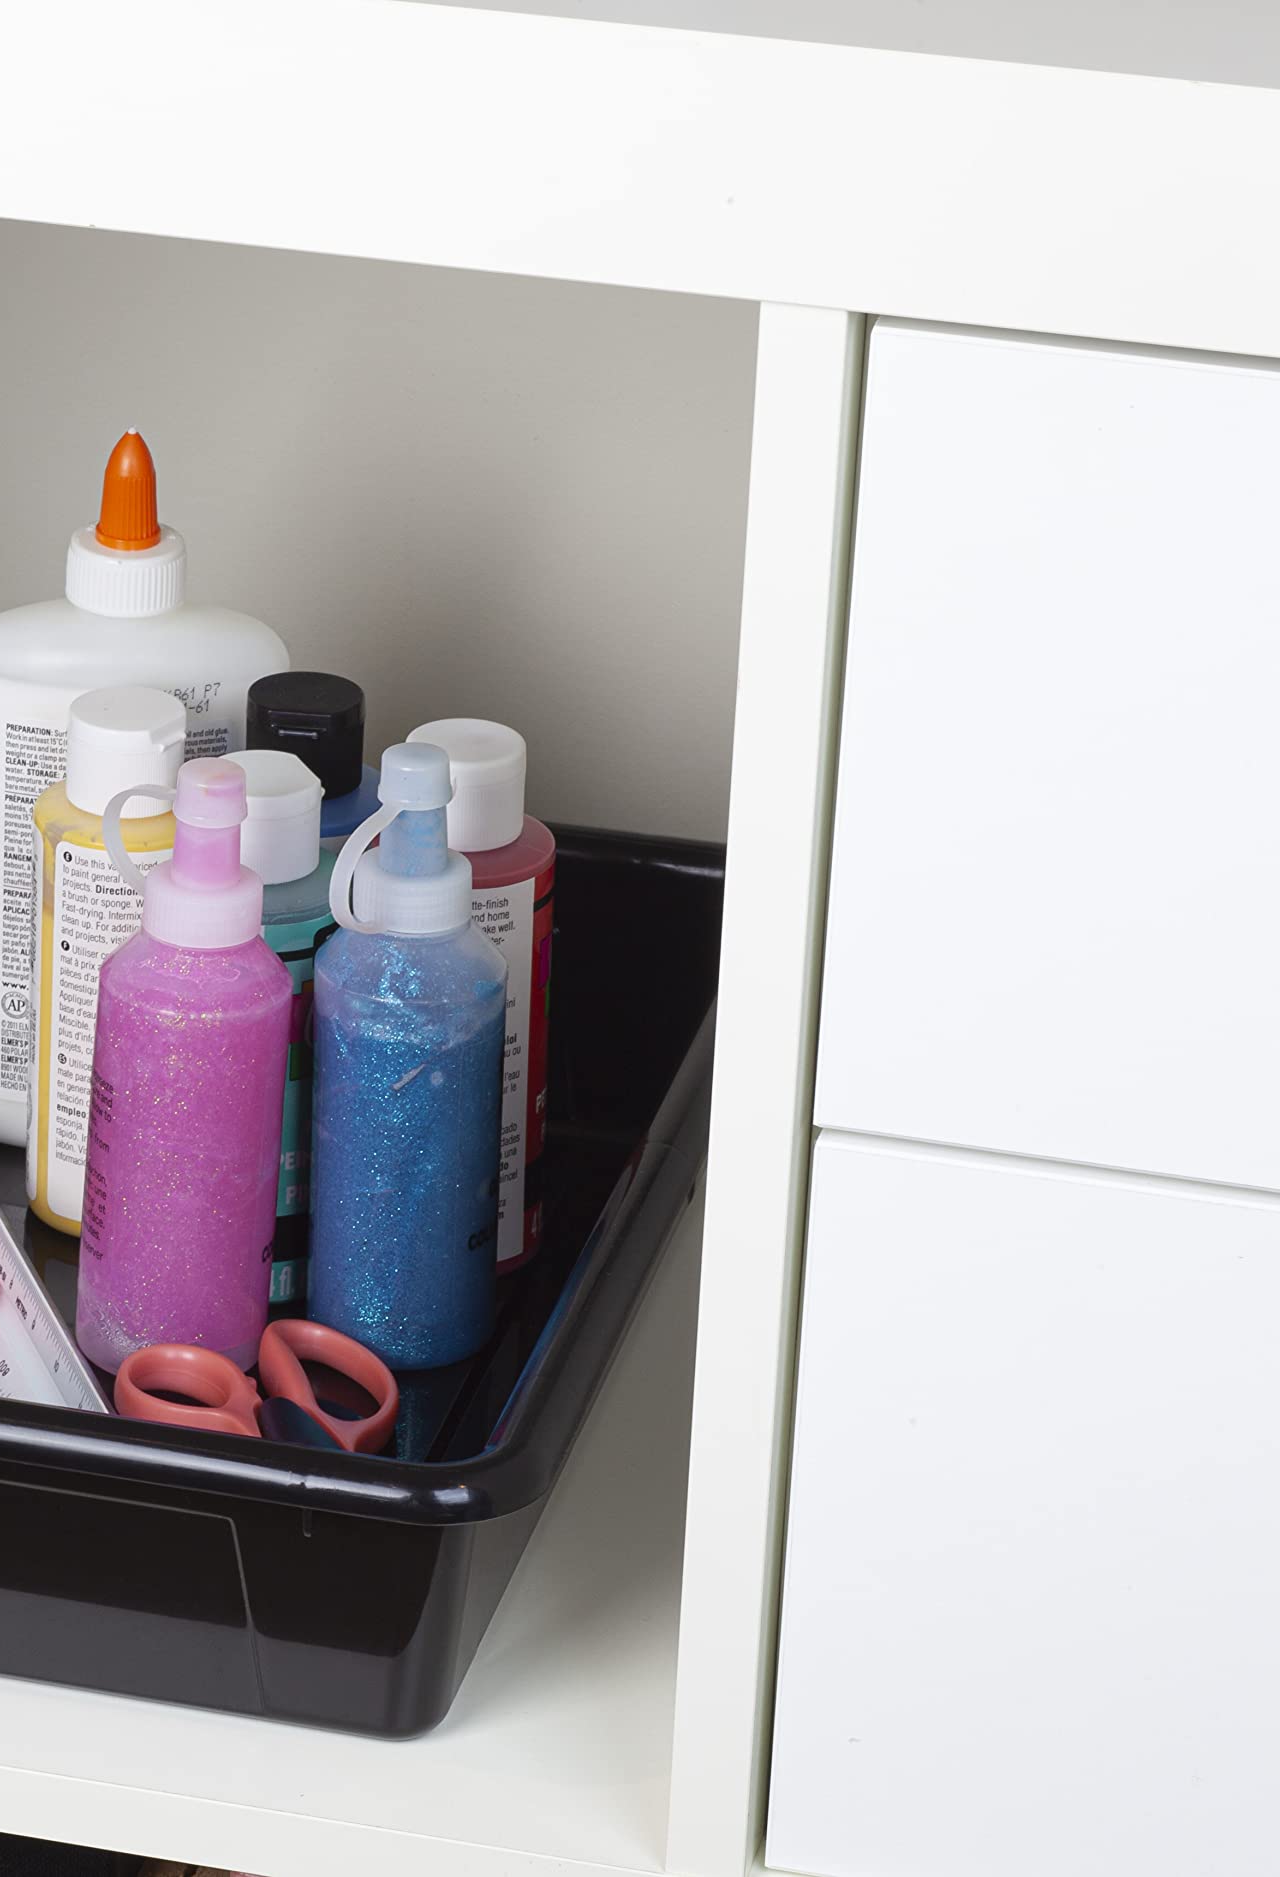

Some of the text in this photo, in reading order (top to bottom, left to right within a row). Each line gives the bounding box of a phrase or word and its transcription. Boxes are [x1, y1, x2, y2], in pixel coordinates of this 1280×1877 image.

[204, 682, 220, 698] P7
[6, 723, 53, 736] PREPARATION:
[6, 732, 20, 740] Work
[35, 736, 49, 744] least
[6, 750, 26, 758] weight
[39, 754, 57, 762] clamp
[6, 757, 40, 768] CLEAN-UP:
[5, 774, 43, 785] temperature.
[27, 769, 60, 778] STORAGE:
[5, 782, 37, 793] bare metal,
[5, 803, 27, 813] saletés,
[5, 812, 21, 820] moins
[4, 820, 31, 829] poreuses
[4, 853, 32, 862] RANGEM
[75, 856, 88, 867] Use
[91, 858, 105, 869] this
[4, 861, 26, 870] debout,
[63, 864, 120, 883] to paint general
[62, 878, 92, 892] projects.
[68, 890, 88, 903] brush
[91, 897, 99, 905] or
[101, 899, 132, 910] sponge.
[3, 905, 30, 915] APLICAC
[62, 901, 141, 920] Fast-drying. Intermix
[487, 910, 510, 922] home
[3, 914, 23, 923] déjelos
[62, 914, 109, 931] clean up. For
[2, 922, 18, 931] luego
[498, 921, 515, 933] well.
[61, 927, 108, 944] and projects,
[72, 946, 99, 959] Utiliser
[2, 962, 14, 970] lave
[61, 955, 72, 965] mat
[81, 961, 96, 970] prix
[2, 971, 29, 980] sumergid
[60, 967, 81, 980] pièces
[2, 981, 29, 990] www.
[60, 979, 97, 995] domestiqu
[60, 990, 94, 1006] Appliquer
[8, 999, 25, 1012] AP
[60, 1002, 96, 1020] base d'eau
[7, 1021, 17, 1029] 2011
[59, 1027, 73, 1038] plus
[1, 1037, 23, 1048] ELMER'S
[58, 1040, 83, 1054] projets,
[1, 1046, 10, 1054] 460
[1, 1054, 23, 1065] ELMER'S
[0, 1072, 16, 1081] MADE
[58, 1067, 74, 1079] mate
[75, 1073, 91, 1083] para
[0, 1080, 26, 1092] HECHO EN
[57, 1080, 65, 1088] en
[511, 1082, 517, 1092] le
[57, 1091, 84, 1106] relación
[56, 1115, 84, 1130] esponja.
[56, 1127, 78, 1140] rápido.
[56, 1140, 75, 1153] jabón.
[504, 1147, 517, 1158] una
[16, 1297, 27, 1320] METRIC
